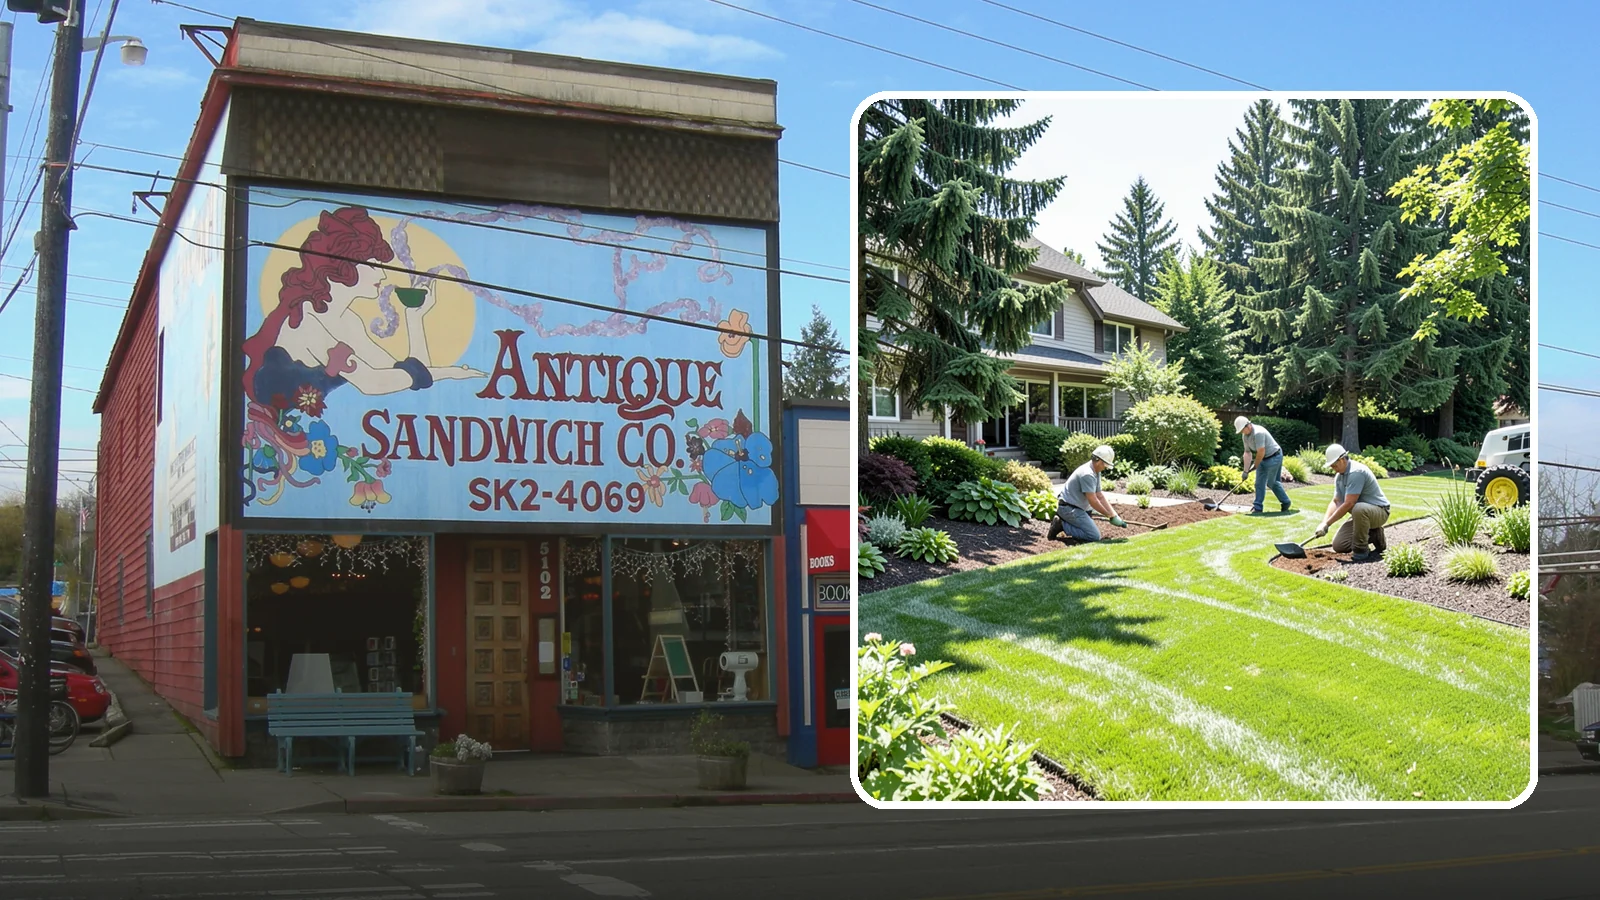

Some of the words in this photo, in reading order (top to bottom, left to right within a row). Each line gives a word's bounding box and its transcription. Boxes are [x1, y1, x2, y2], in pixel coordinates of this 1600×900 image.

[476, 329, 723, 420] ANTIQUE
[360, 409, 604, 467] SANDWICH
[617, 422, 686, 468] CO.
[468, 478, 647, 511] SK2-4069
[540, 541, 551, 599] 5102
[809, 555, 835, 569] BOOKS
